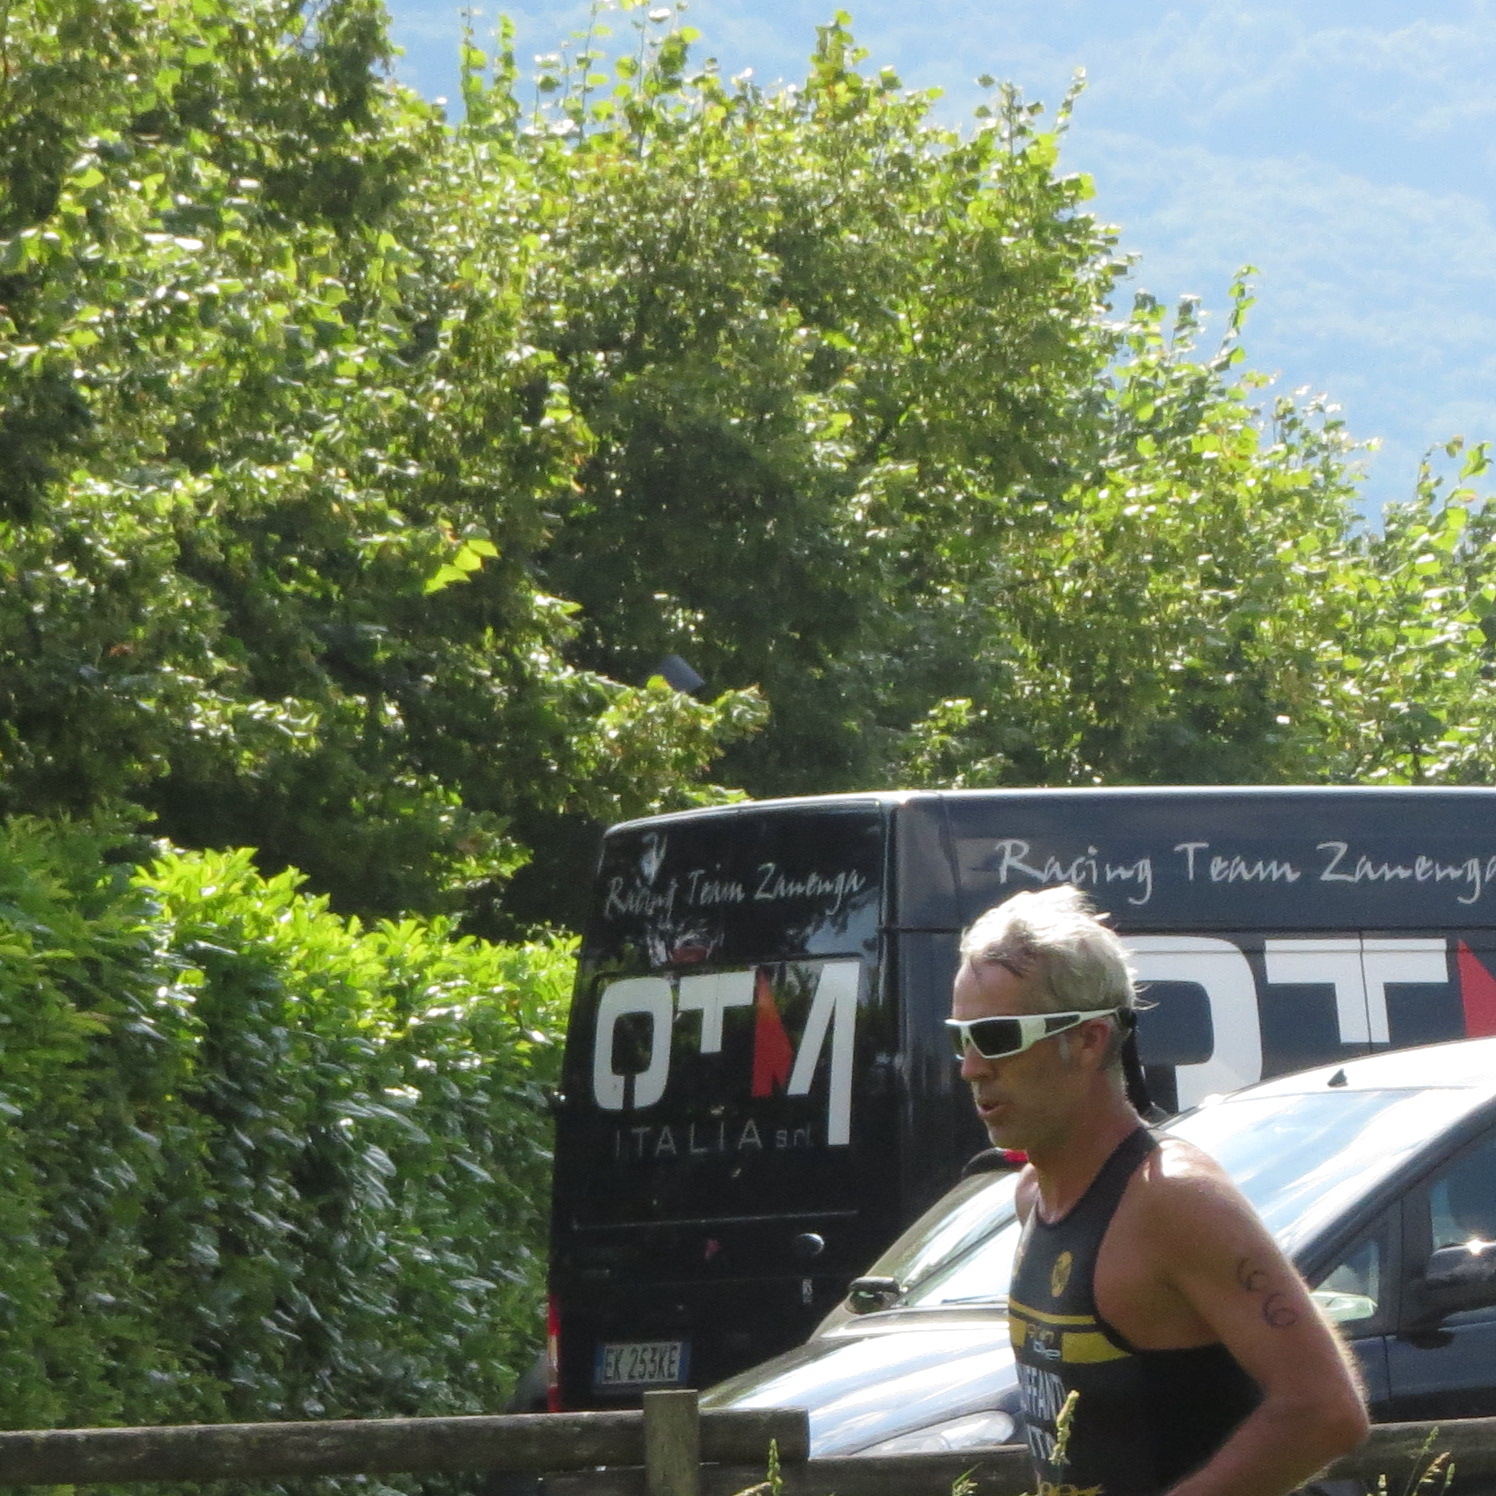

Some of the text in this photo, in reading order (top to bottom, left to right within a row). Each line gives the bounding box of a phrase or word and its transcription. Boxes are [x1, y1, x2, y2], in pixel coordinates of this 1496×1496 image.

[994, 839, 1153, 905] Racing
[1174, 842, 1300, 882] Team
[614, 1117, 763, 1159] ITALIA
